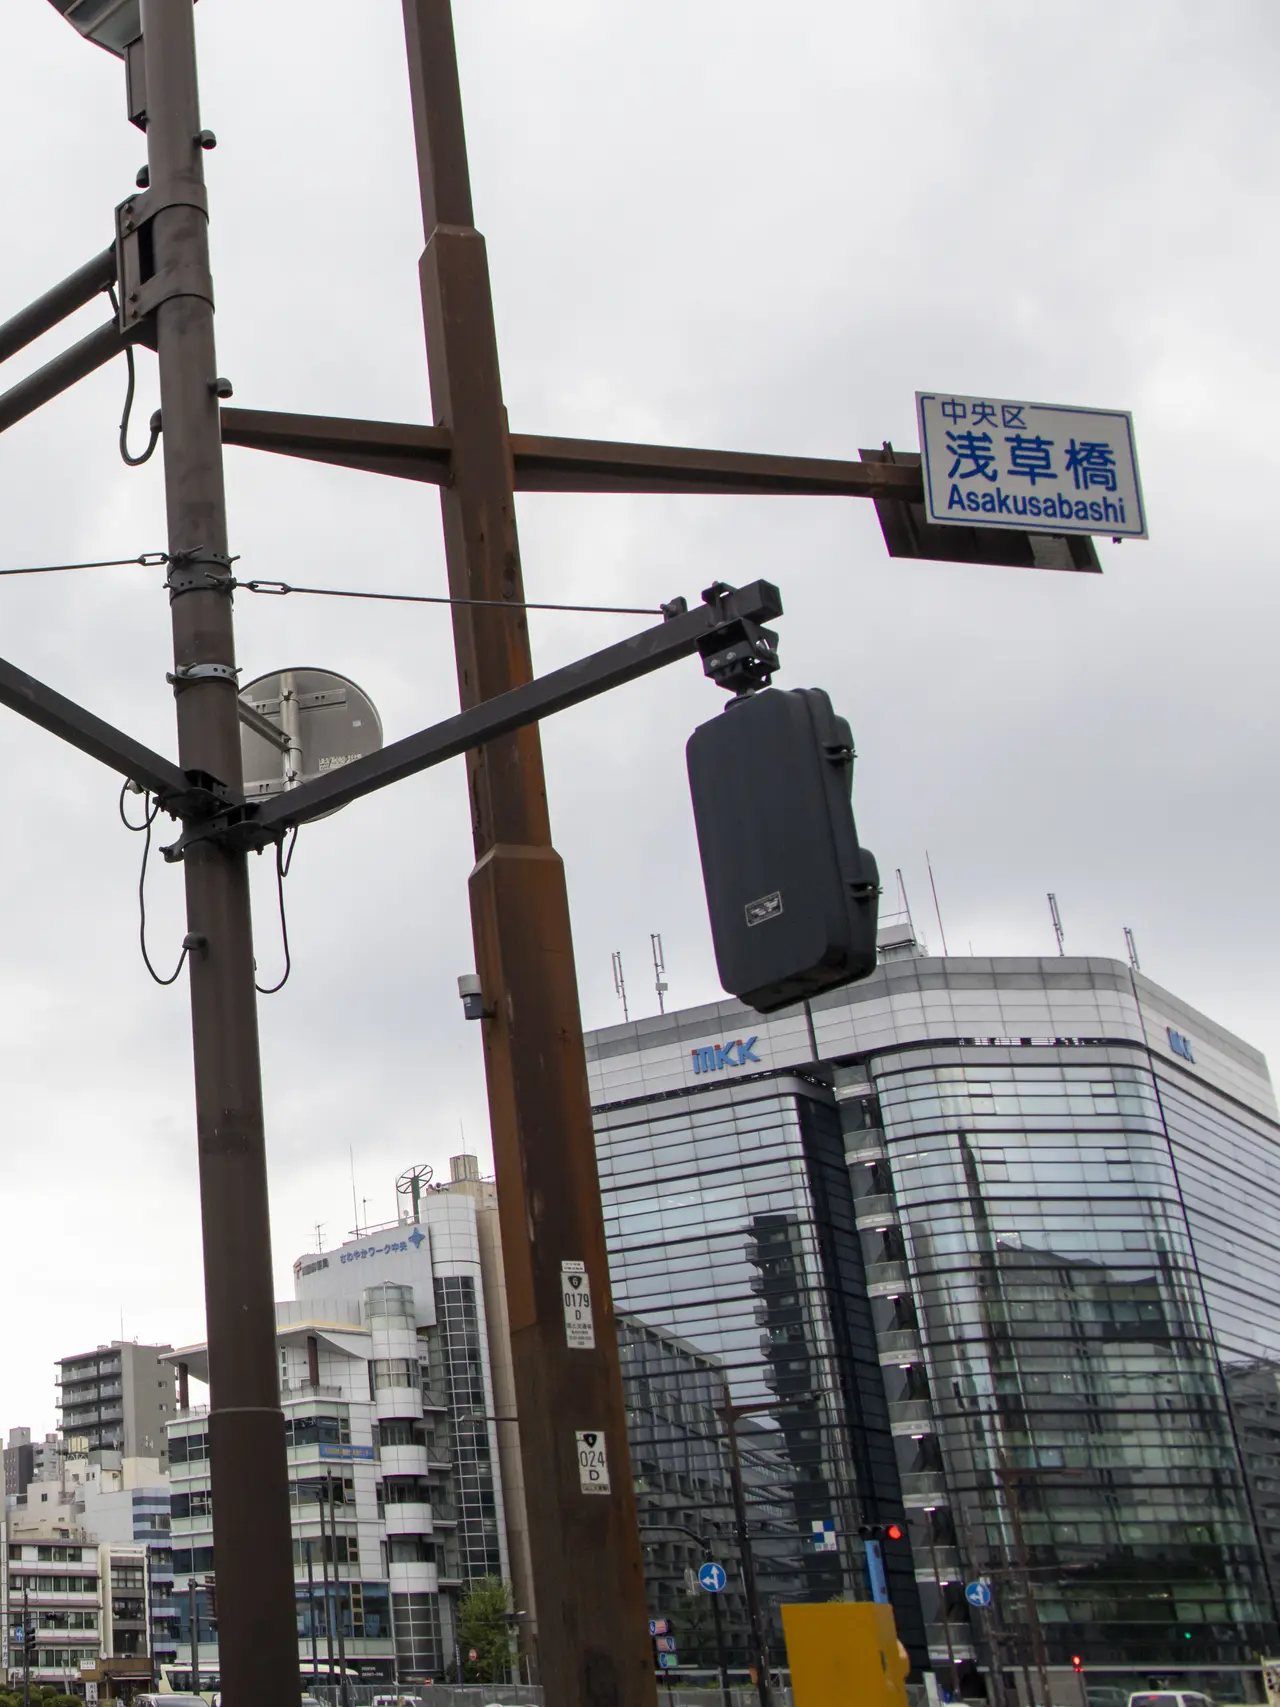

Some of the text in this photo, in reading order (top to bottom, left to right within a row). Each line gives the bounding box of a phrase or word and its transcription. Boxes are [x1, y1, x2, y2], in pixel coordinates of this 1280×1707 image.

[941, 399, 1027, 430] 中央区
[945, 430, 1117, 492] 浅草橋
[947, 483, 1126, 523] Asakusabashi
[339, 1240, 409, 1264] さわやかワーク中央
[564, 1292, 590, 1308] 0179
[580, 1451, 605, 1468] 024
[589, 1470, 600, 1481] D
